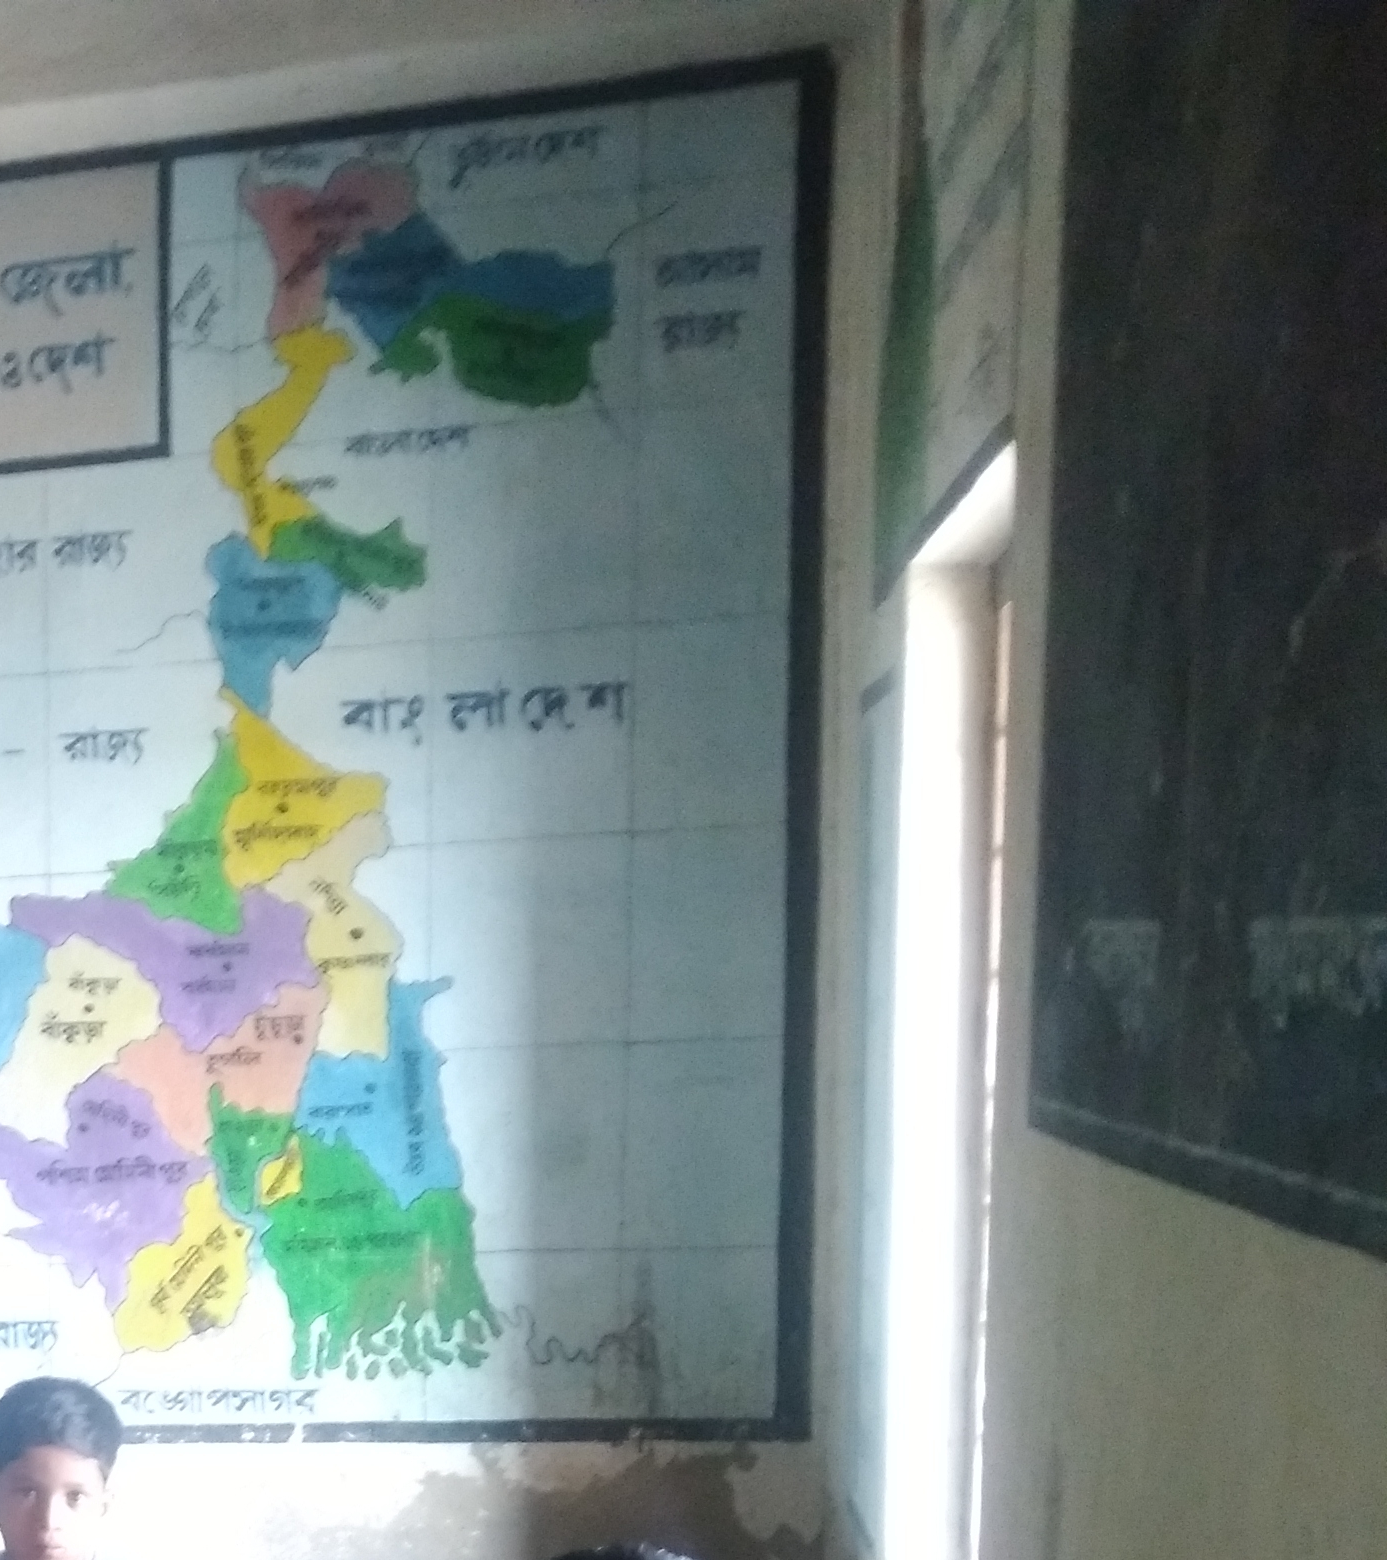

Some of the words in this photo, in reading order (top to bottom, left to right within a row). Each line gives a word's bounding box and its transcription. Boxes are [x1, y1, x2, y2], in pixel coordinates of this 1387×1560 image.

[0, 242, 137, 317] জেলা
[30, 328, 116, 397] দেশ
[52, 529, 134, 573] রাজ্য
[58, 725, 151, 766] রাজ্য
